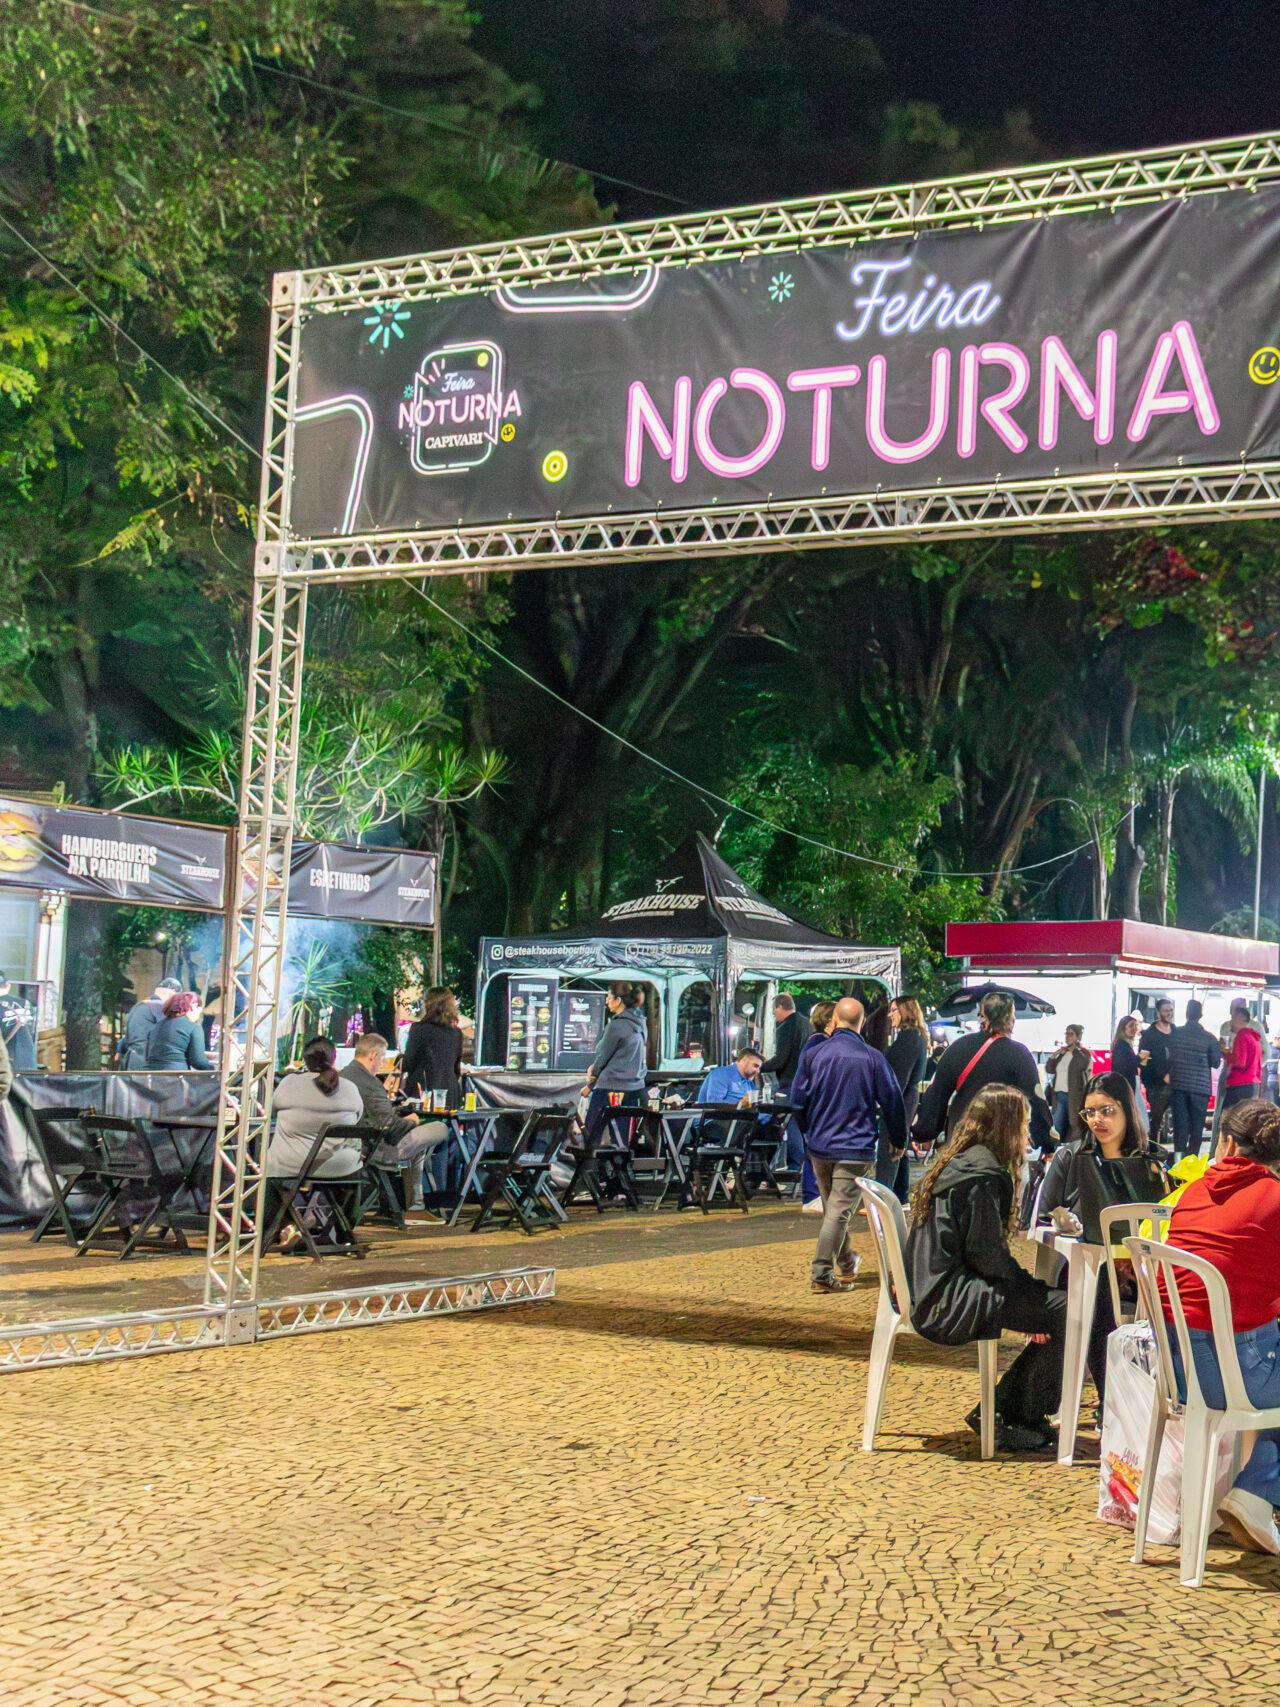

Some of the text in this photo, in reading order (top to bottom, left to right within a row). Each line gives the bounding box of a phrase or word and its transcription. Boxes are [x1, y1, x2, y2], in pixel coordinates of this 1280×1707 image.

[836, 256, 1000, 342] Feira
[442, 372, 476, 393] Feira
[398, 389, 522, 430] NOTURNA
[625, 320, 1221, 487] NOTURNA
[425, 432, 483, 450] CAPIVARI
[62, 834, 158, 866] HAMBURGUERS
[67, 854, 150, 884] NA PARRILHA
[601, 894, 706, 919] STEAKHOUSE
